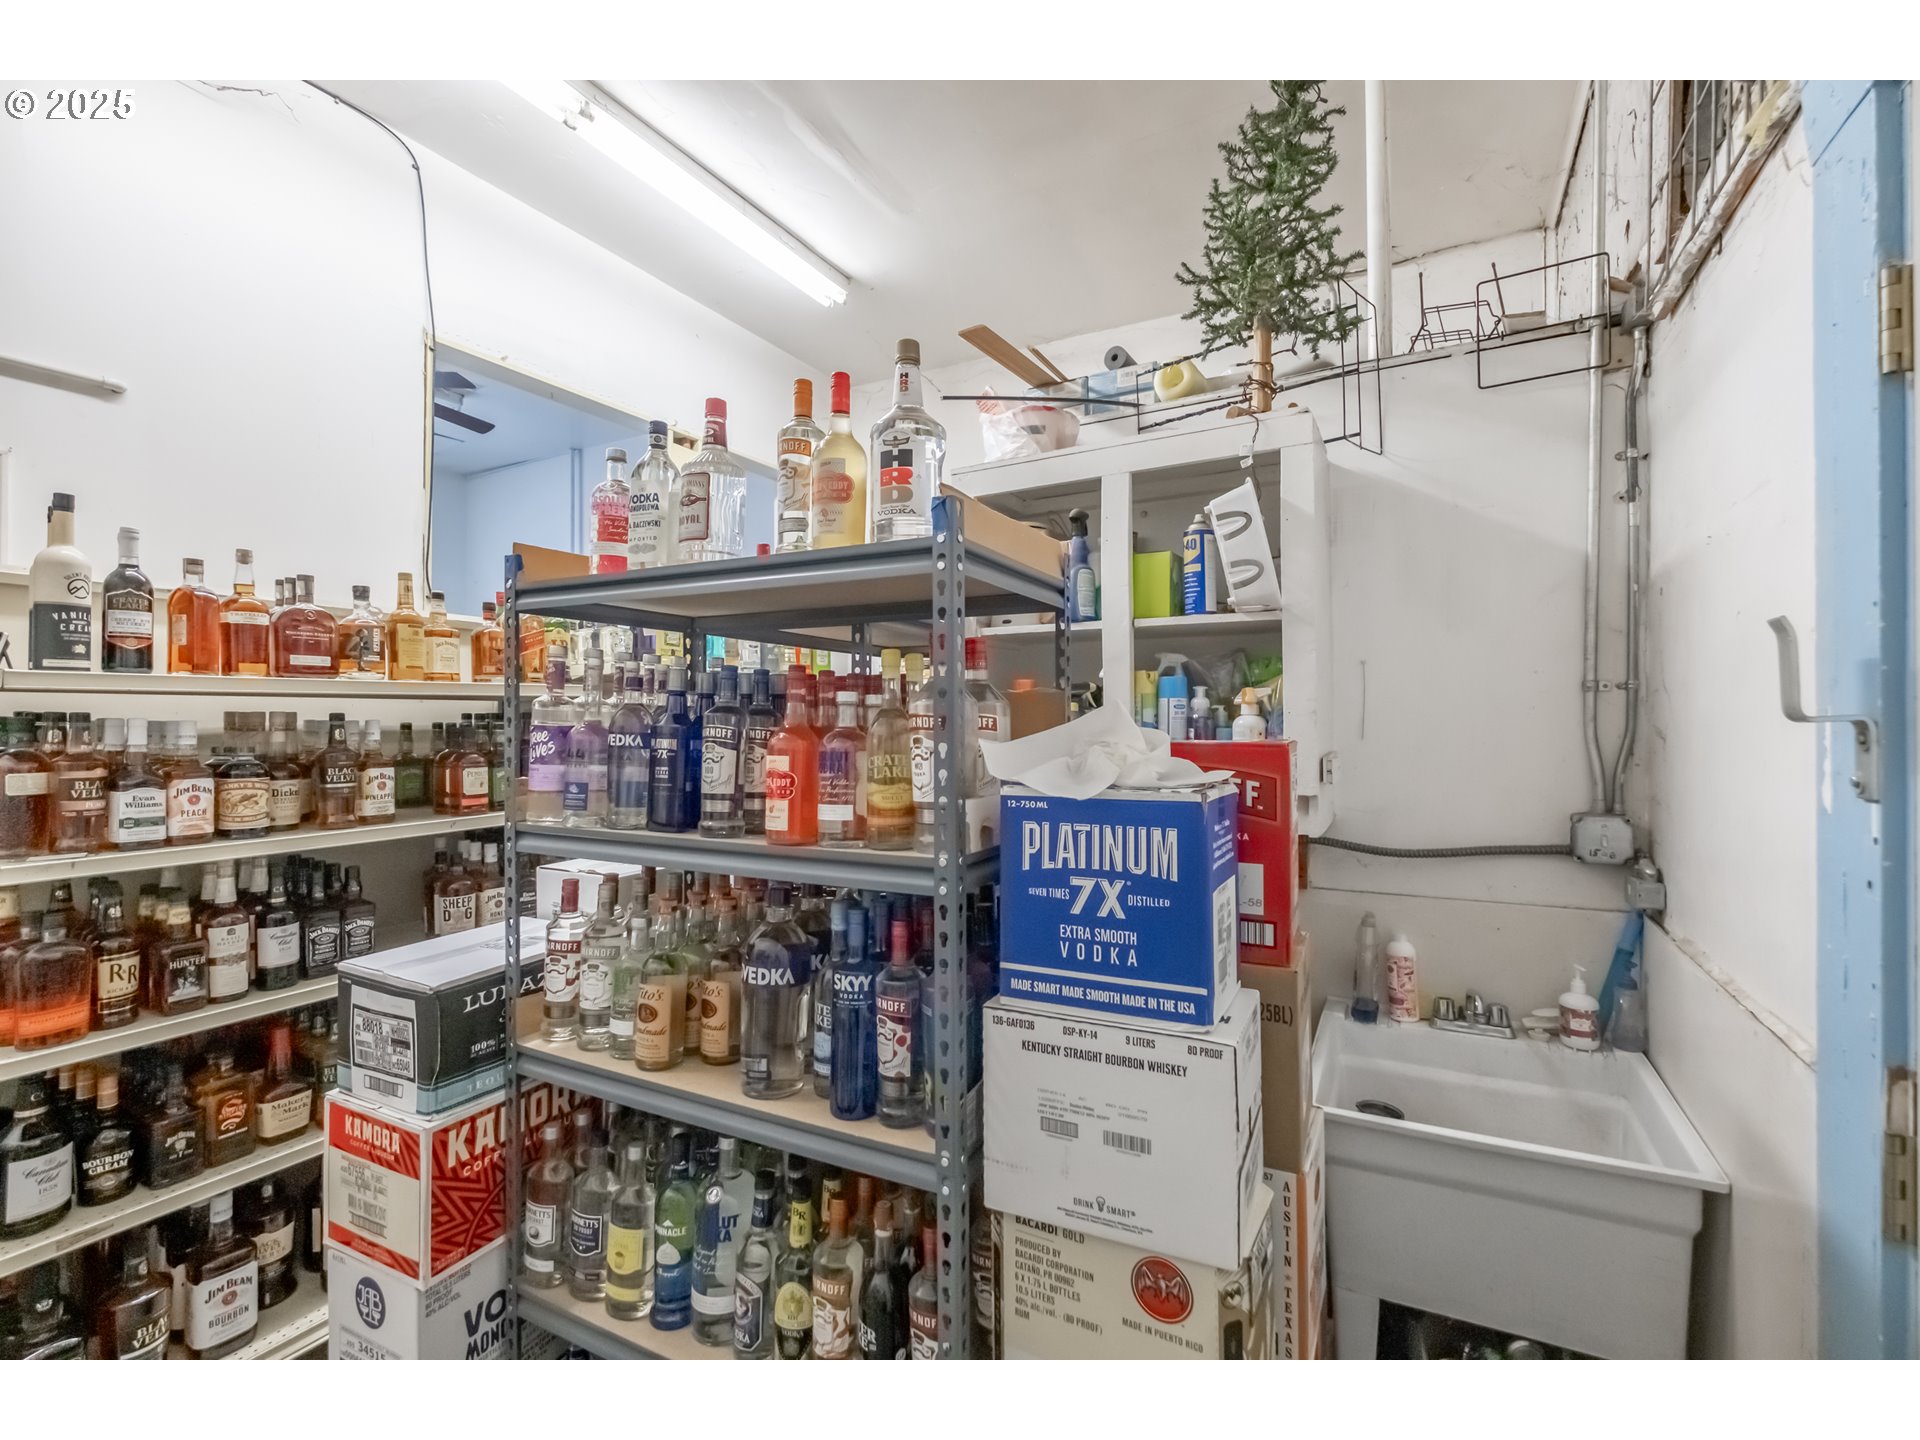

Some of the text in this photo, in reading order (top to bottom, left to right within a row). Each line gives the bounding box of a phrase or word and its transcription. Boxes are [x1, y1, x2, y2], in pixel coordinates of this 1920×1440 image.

[781, 441, 806, 452] NOFF
[877, 508, 917, 517] VODKA
[750, 729, 771, 739] NOFF
[657, 749, 668, 759] 7X
[327, 766, 355, 775] BLAC
[366, 775, 379, 785] JIM
[173, 783, 213, 799] JIM BEAM
[124, 801, 163, 809] Williams
[180, 808, 208, 818] PEACH
[1007, 799, 1049, 809] 12-750 ML
[1022, 820, 1178, 882] PLATINUM
[442, 896, 473, 909] SHEEP
[1028, 876, 1171, 920] SEVEN TIMES 7X DISTILLED
[1059, 924, 1138, 946] EXTRA SMOOTH
[1059, 940, 1138, 967] VODKA
[834, 973, 873, 992] SKYY
[1010, 977, 1196, 1015] MADE SMART MADE SMOOTH MADE IN THE USA
[470, 1040, 496, 1054] 100%
[1131, 1036, 1156, 1050] LITERS
[1187, 1044, 1198, 1056] 80
[1199, 1046, 1224, 1061] PROOF
[1021, 1039, 1188, 1078] KENTUCKY STRAIGHT BOURBON WHISKEY
[466, 1073, 504, 1093] TEQU
[271, 1094, 311, 1112] Maker's
[282, 1101, 310, 1115] Mark
[344, 1113, 400, 1154] KAMORA
[82, 1149, 135, 1170] BOURBON
[88, 1158, 128, 1176] CREAM
[463, 1150, 506, 1177] COFF
[1073, 1197, 1094, 1210] DRINK
[1015, 1216, 1059, 1237] BACARDI
[1062, 1227, 1085, 1245] GOLD
[1015, 1236, 1062, 1259] PRODUCED BY
[1015, 1248, 1044, 1266] BACARDI
[1045, 1257, 1095, 1283] CORPORATION
[1043, 1269, 1053, 1280] PR
[1282, 1181, 1293, 1359] AUSTIN TEXAS
[204, 1275, 253, 1304] JIM BEAM
[815, 1280, 845, 1296] RNOFF
[1015, 1284, 1056, 1306] 10.5 LITERS
[1027, 1275, 1042, 1289] 1.75
[1049, 1283, 1081, 1303] BOTTLES
[208, 1303, 250, 1329] BOURBON
[911, 1311, 937, 1329] RNOF
[1014, 1306, 1030, 1320] RUM
[1121, 1316, 1205, 1354] MADE IN PUERTO RICO
